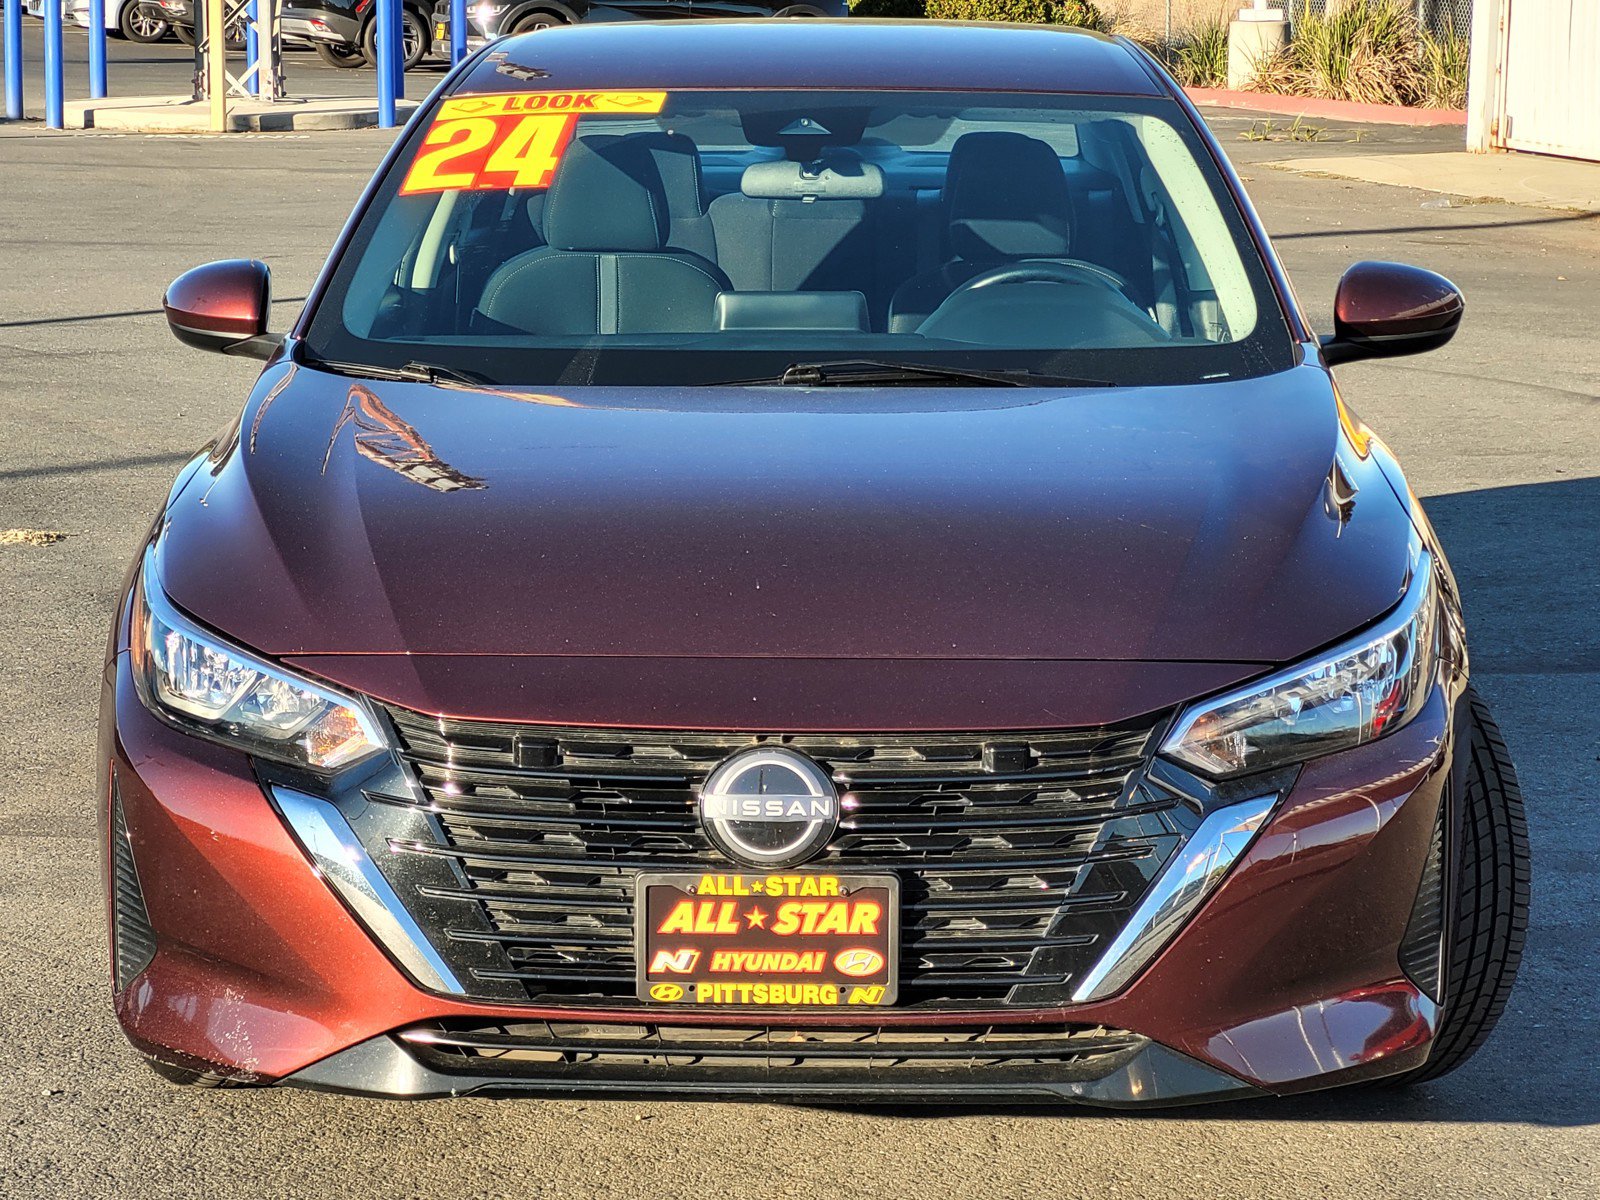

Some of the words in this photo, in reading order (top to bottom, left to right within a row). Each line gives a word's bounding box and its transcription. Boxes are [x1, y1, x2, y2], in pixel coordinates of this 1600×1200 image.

[502, 94, 600, 111] LOOK
[403, 116, 568, 191] 24
[708, 799, 830, 817] NISSAN
[697, 876, 749, 896] ALL
[765, 878, 838, 896] STAR
[657, 901, 740, 934] ALL
[770, 901, 880, 935] STAR
[709, 950, 827, 973] HYUNDAI
[696, 983, 837, 1004] PITTSBURG
